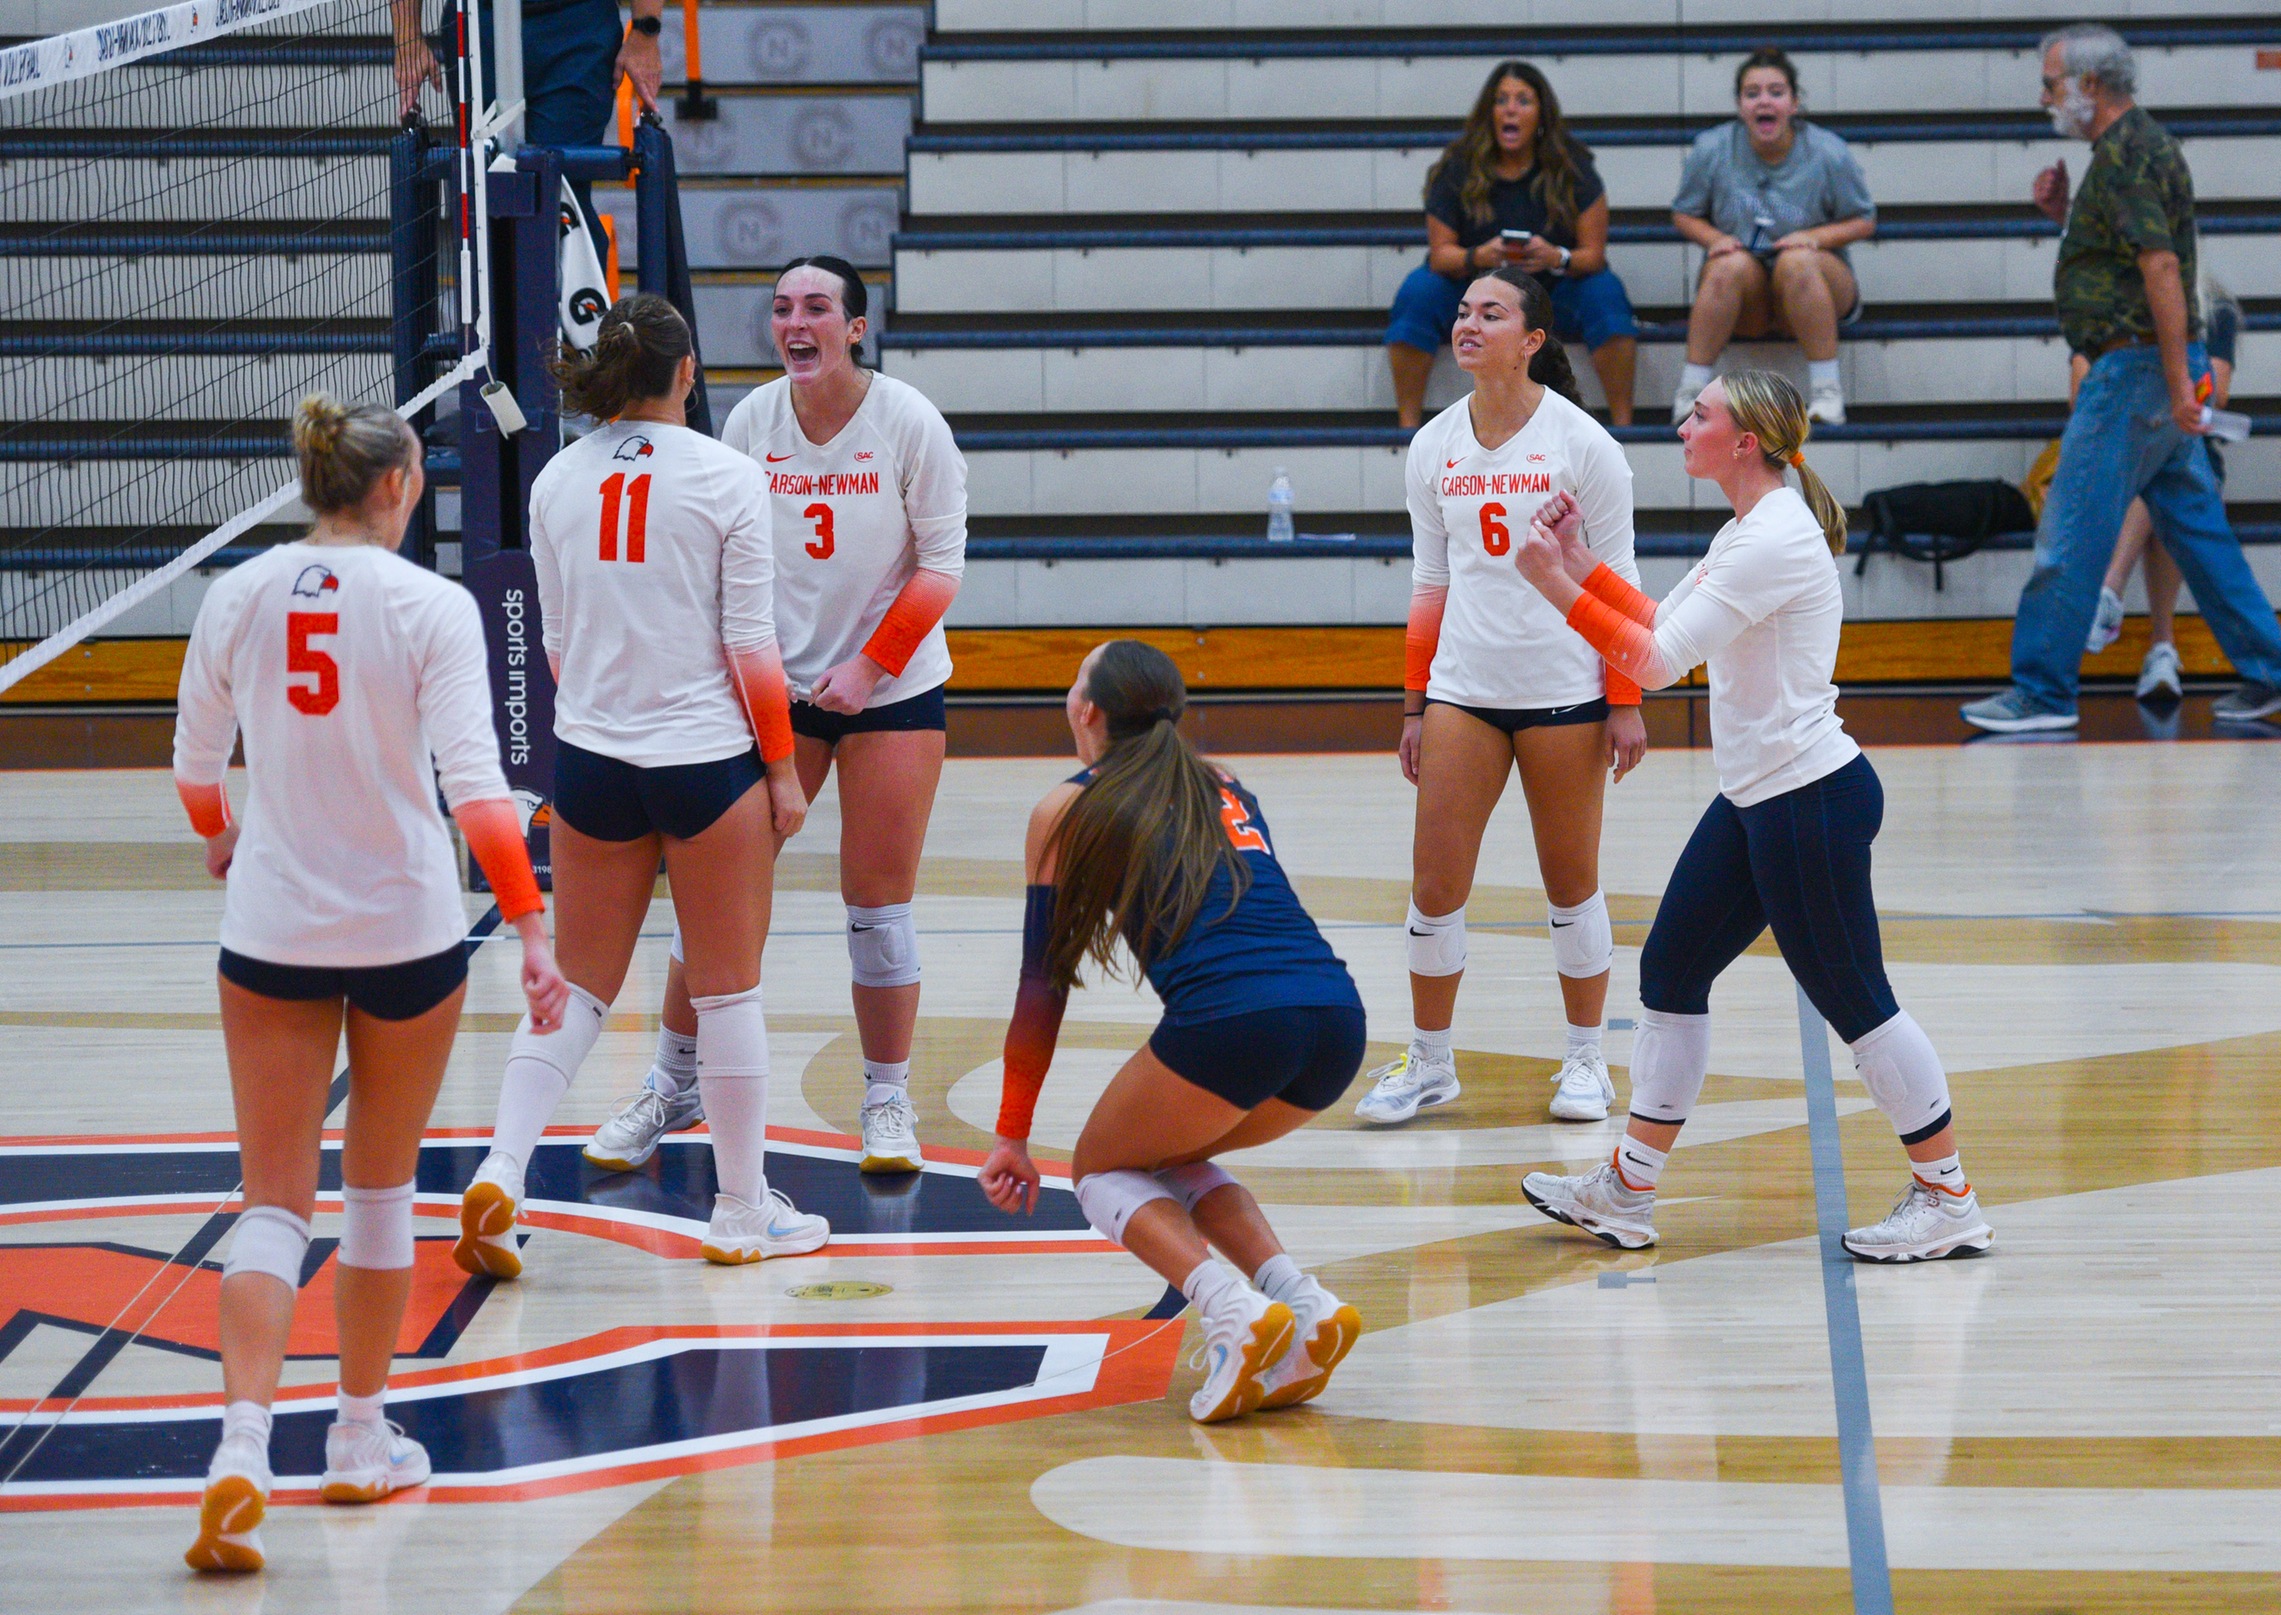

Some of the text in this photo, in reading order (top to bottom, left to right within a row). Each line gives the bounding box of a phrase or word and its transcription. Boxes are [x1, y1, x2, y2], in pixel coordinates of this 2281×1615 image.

[765, 471, 879, 496] ARSON-NEWMAN
[1441, 473, 1550, 497] CARSON-NEWMAN
[598, 471, 653, 564] 11
[803, 502, 835, 560] 3
[1478, 502, 1511, 557] 6
[286, 611, 340, 716] 5
[501, 588, 531, 766] sports imports
